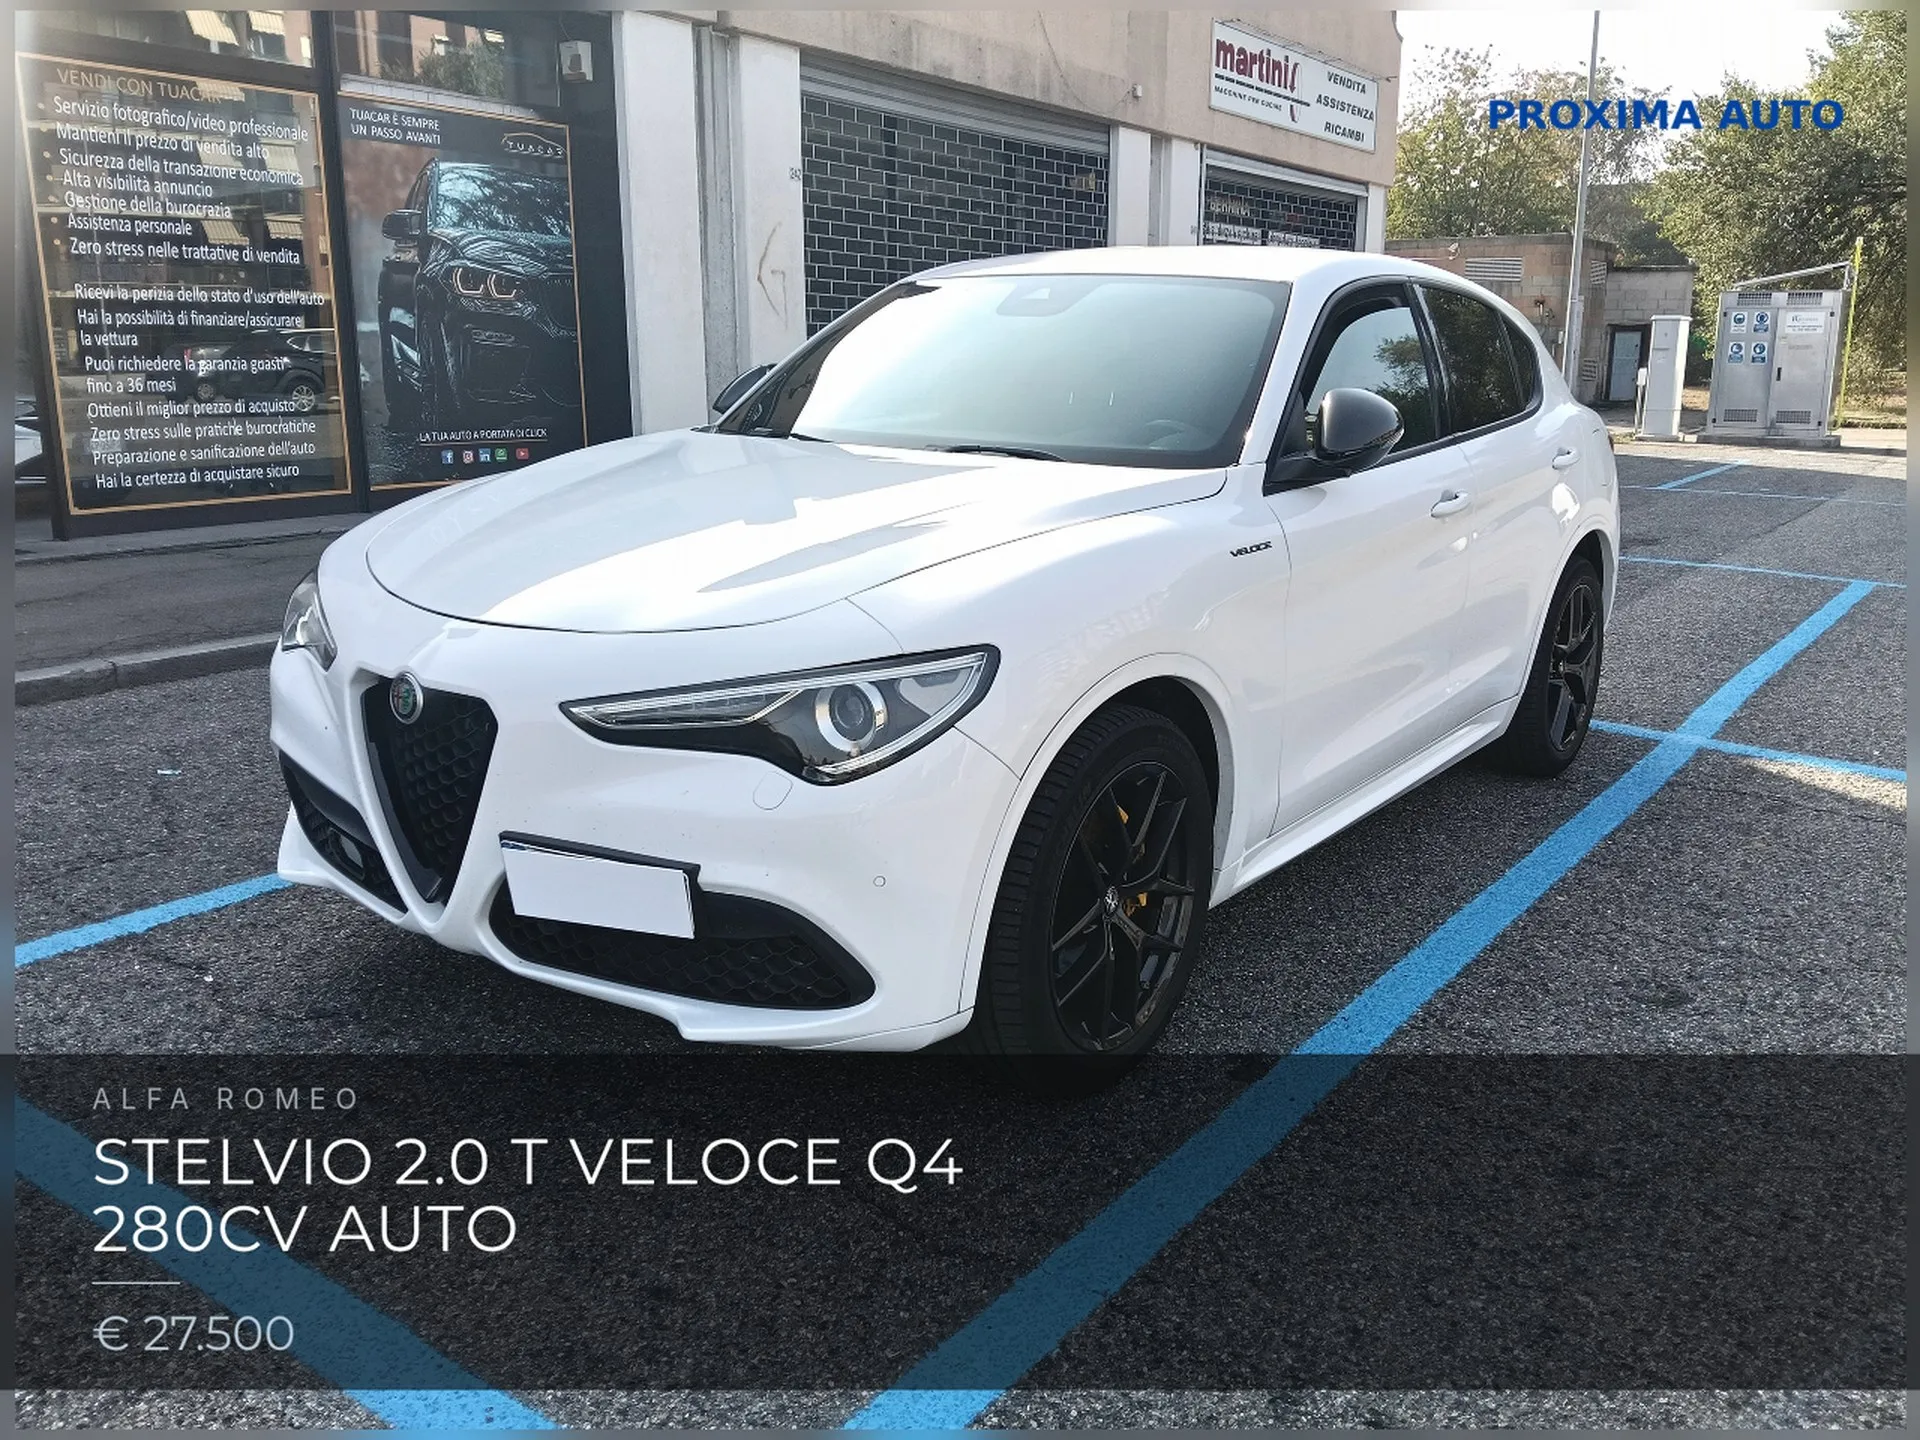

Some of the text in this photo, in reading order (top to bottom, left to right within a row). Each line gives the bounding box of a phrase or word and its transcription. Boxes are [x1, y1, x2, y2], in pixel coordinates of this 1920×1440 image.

[1215, 37, 1288, 90] martini
[57, 69, 111, 90] VENDI
[116, 76, 152, 96] CON
[1327, 71, 1366, 94] VENDITA
[54, 96, 308, 142] Servizio fotografico/video professionale
[349, 107, 391, 124] TUACAR
[401, 115, 440, 131] SEMPRE
[1316, 94, 1375, 121] ASSISTENZA
[56, 122, 269, 159] Mantieni il prezzo di vendita alto
[351, 123, 440, 144] UN PASSO AVANTI
[1324, 121, 1365, 142] RICAMBI
[59, 148, 304, 186] Sicurezza della transazione economica
[63, 169, 213, 198] Alta visibilità annuncio
[65, 190, 231, 218] Gestione della burocrazia
[67, 213, 192, 236] Assistenza personale
[70, 237, 300, 265] Zero stress nelle trattative di vendita
[74, 283, 113, 300] Ricevi
[117, 285, 129, 300] la
[132, 287, 174, 303] perizia
[177, 287, 208, 303] dello
[211, 290, 240, 303] stato
[276, 290, 325, 305] dell'auto
[77, 308, 301, 329] Hai la possibilità di finanziare/assicurare
[80, 331, 139, 346] la vettura
[85, 356, 115, 372] Puoi
[118, 356, 182, 371] richiedere
[185, 356, 196, 371] la
[198, 357, 248, 373] garanzia
[87, 377, 176, 393] fino a 36 mesi
[88, 400, 295, 418] Ottieni il miglior prezzo di acquisto
[90, 419, 316, 442] Zero stress sulle pratiche burocratiche
[419, 428, 547, 441] LA TUA AUTO A PORTATA DI CLICK
[93, 442, 315, 466] Preparazione e sanificazione dell'auto
[96, 464, 300, 489] Hai la certezza di acquistare sicuro
[1230, 541, 1272, 557] VELOCE
